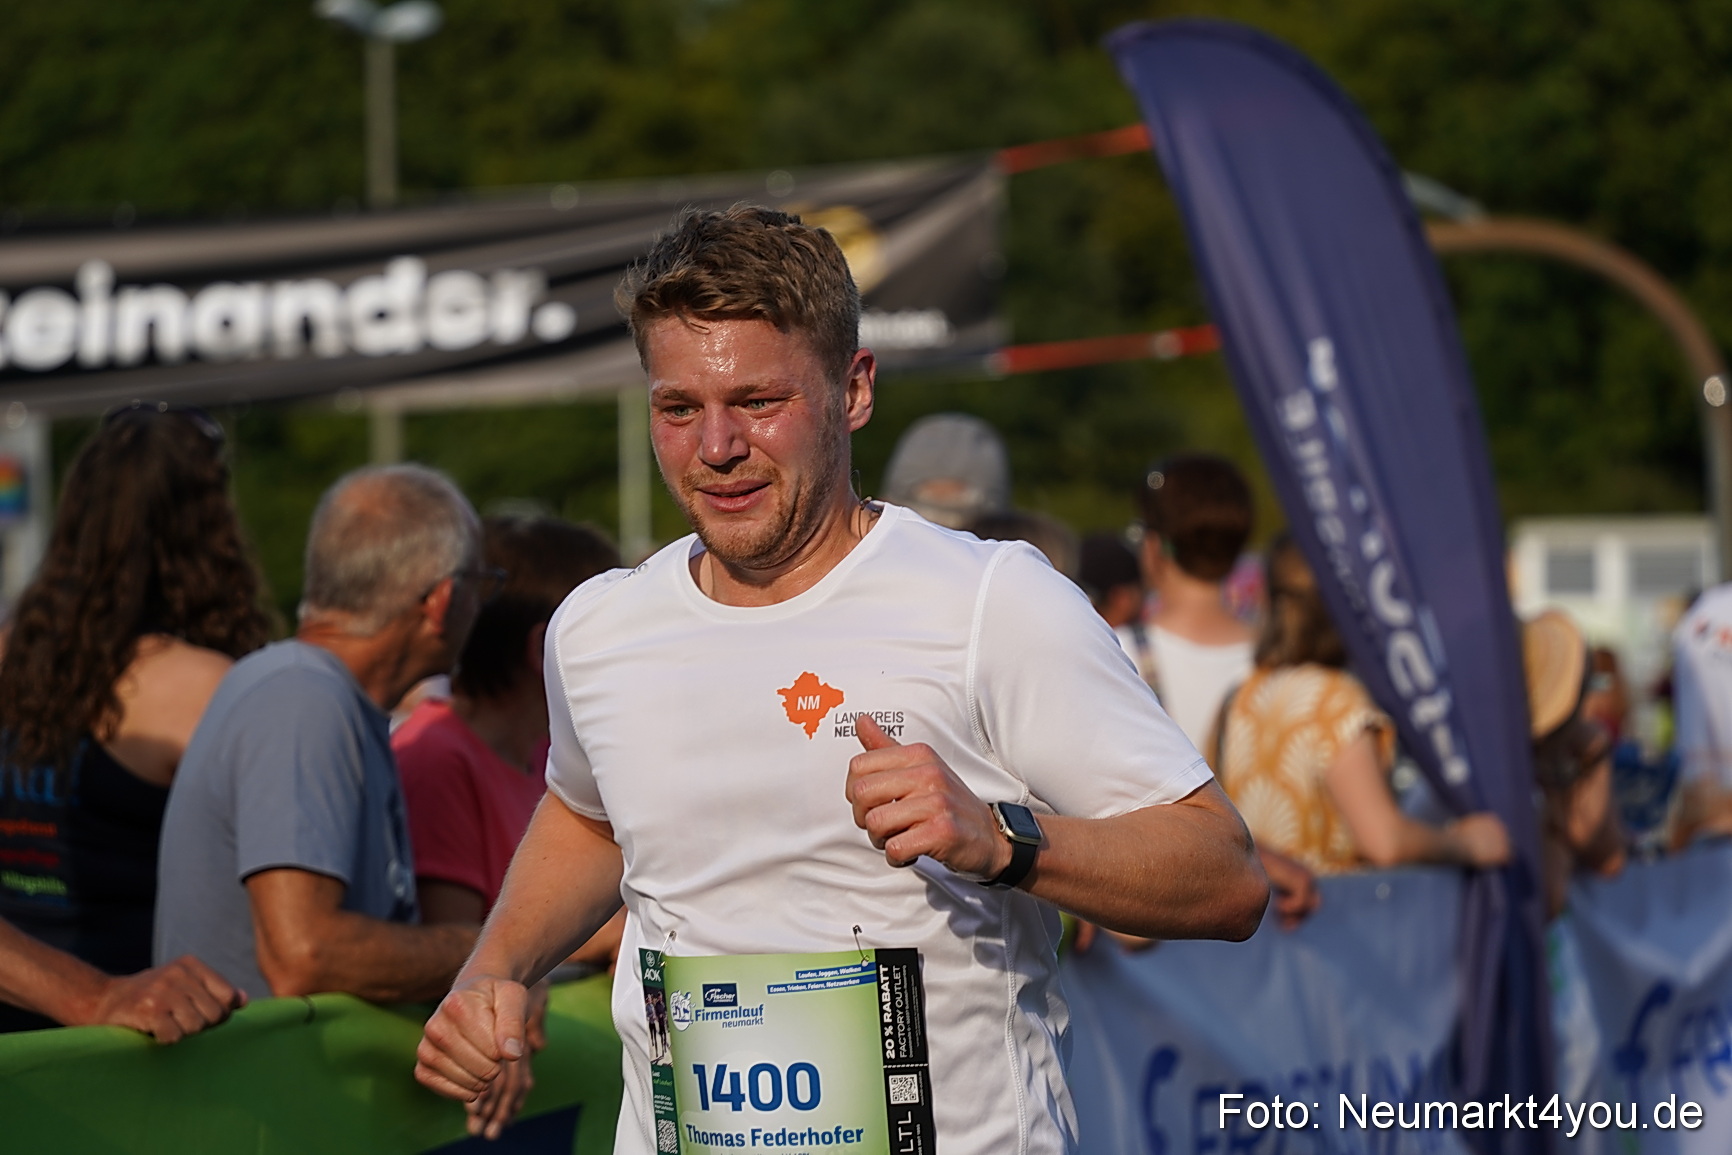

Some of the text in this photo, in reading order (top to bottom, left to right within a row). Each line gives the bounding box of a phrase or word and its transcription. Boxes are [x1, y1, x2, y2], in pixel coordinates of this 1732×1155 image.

[0, 254, 576, 371] einander.
[797, 695, 821, 711] NM
[834, 725, 905, 738] NEURKT
[643, 968, 662, 982] AOK
[892, 964, 904, 1009] OUTLET
[879, 964, 893, 1023] RABATT
[694, 1003, 764, 1022] Firmenlauf
[721, 1016, 764, 1029] neumarkt
[896, 1010, 908, 1059] FACTORY
[885, 1038, 896, 1060] 20
[692, 1061, 822, 1112] 1400
[685, 1123, 864, 1148] Thomas Federhofer
